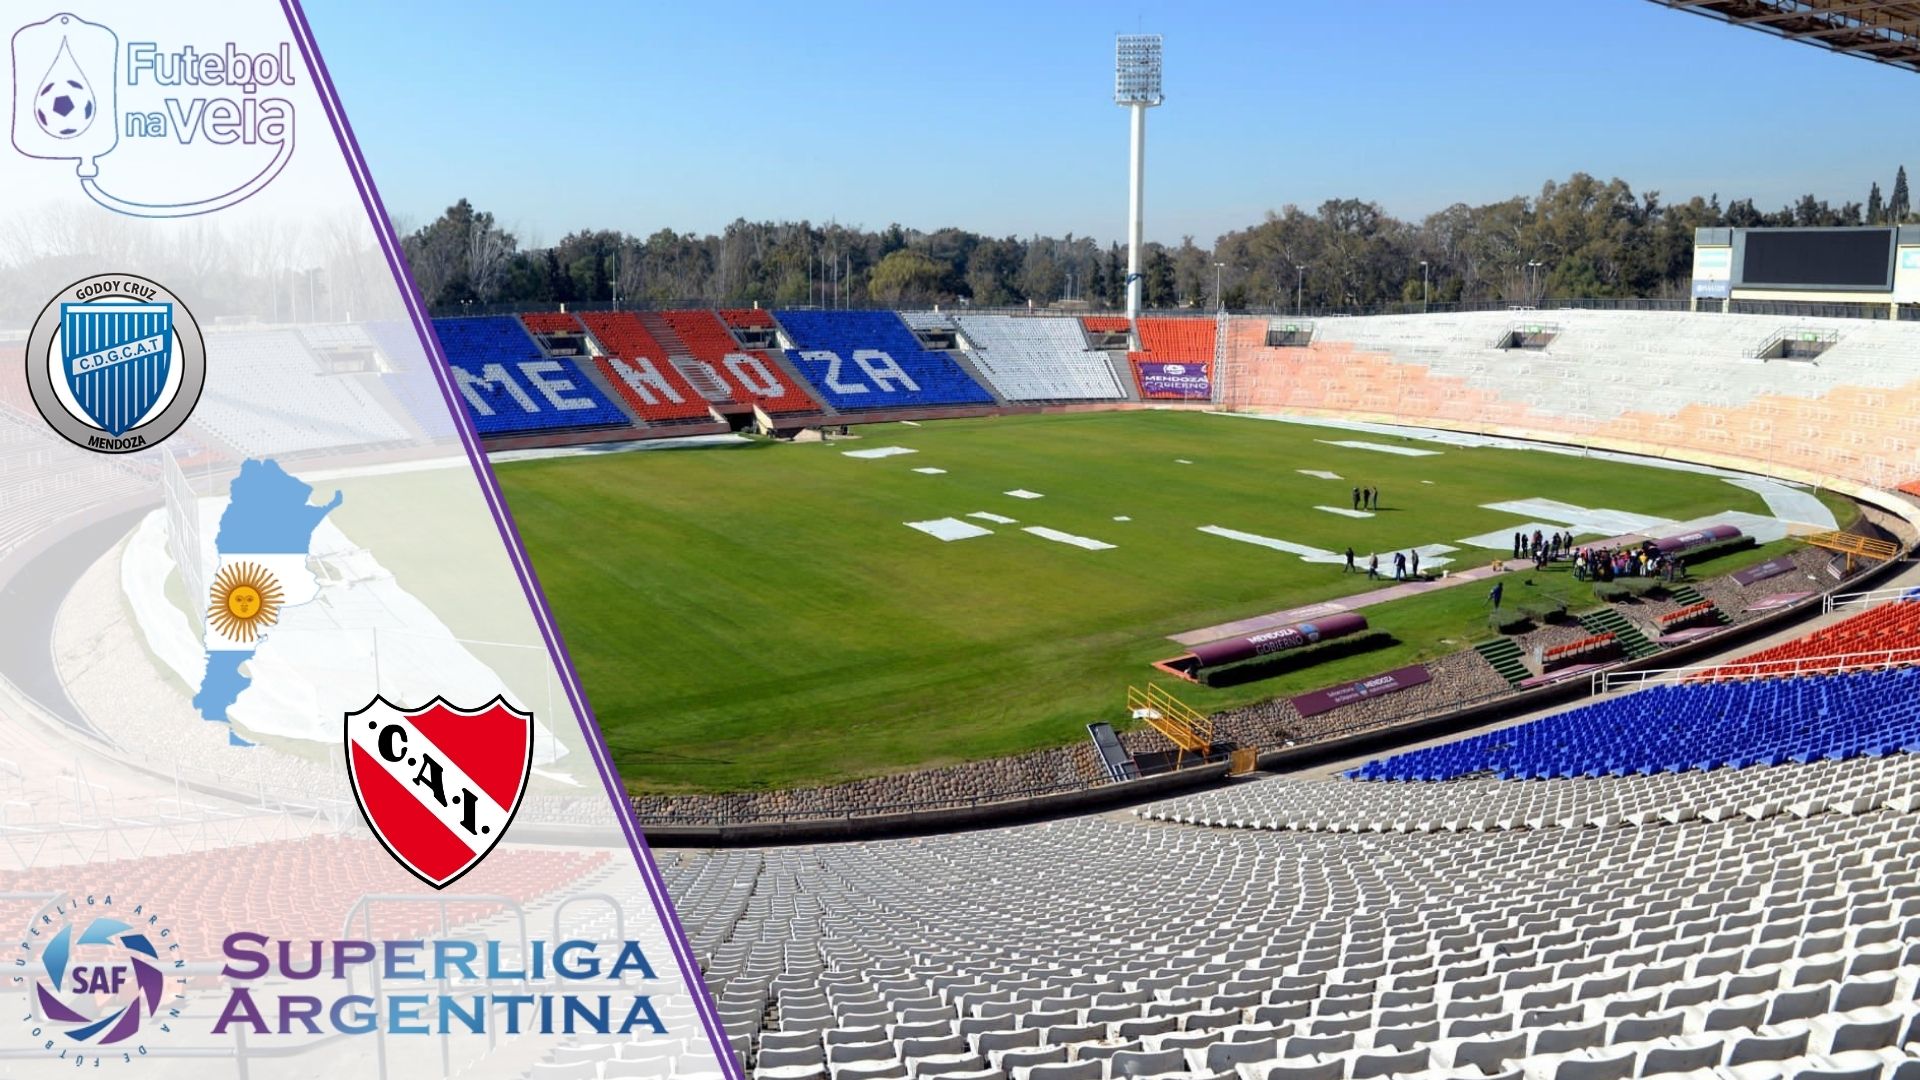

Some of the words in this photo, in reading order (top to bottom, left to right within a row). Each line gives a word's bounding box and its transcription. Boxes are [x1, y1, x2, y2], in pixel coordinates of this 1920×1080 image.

[1145, 375, 1208, 383] MENDOZA
[1247, 628, 1298, 644] MENDOZA
[1256, 635, 1304, 655] GOBIERNO
